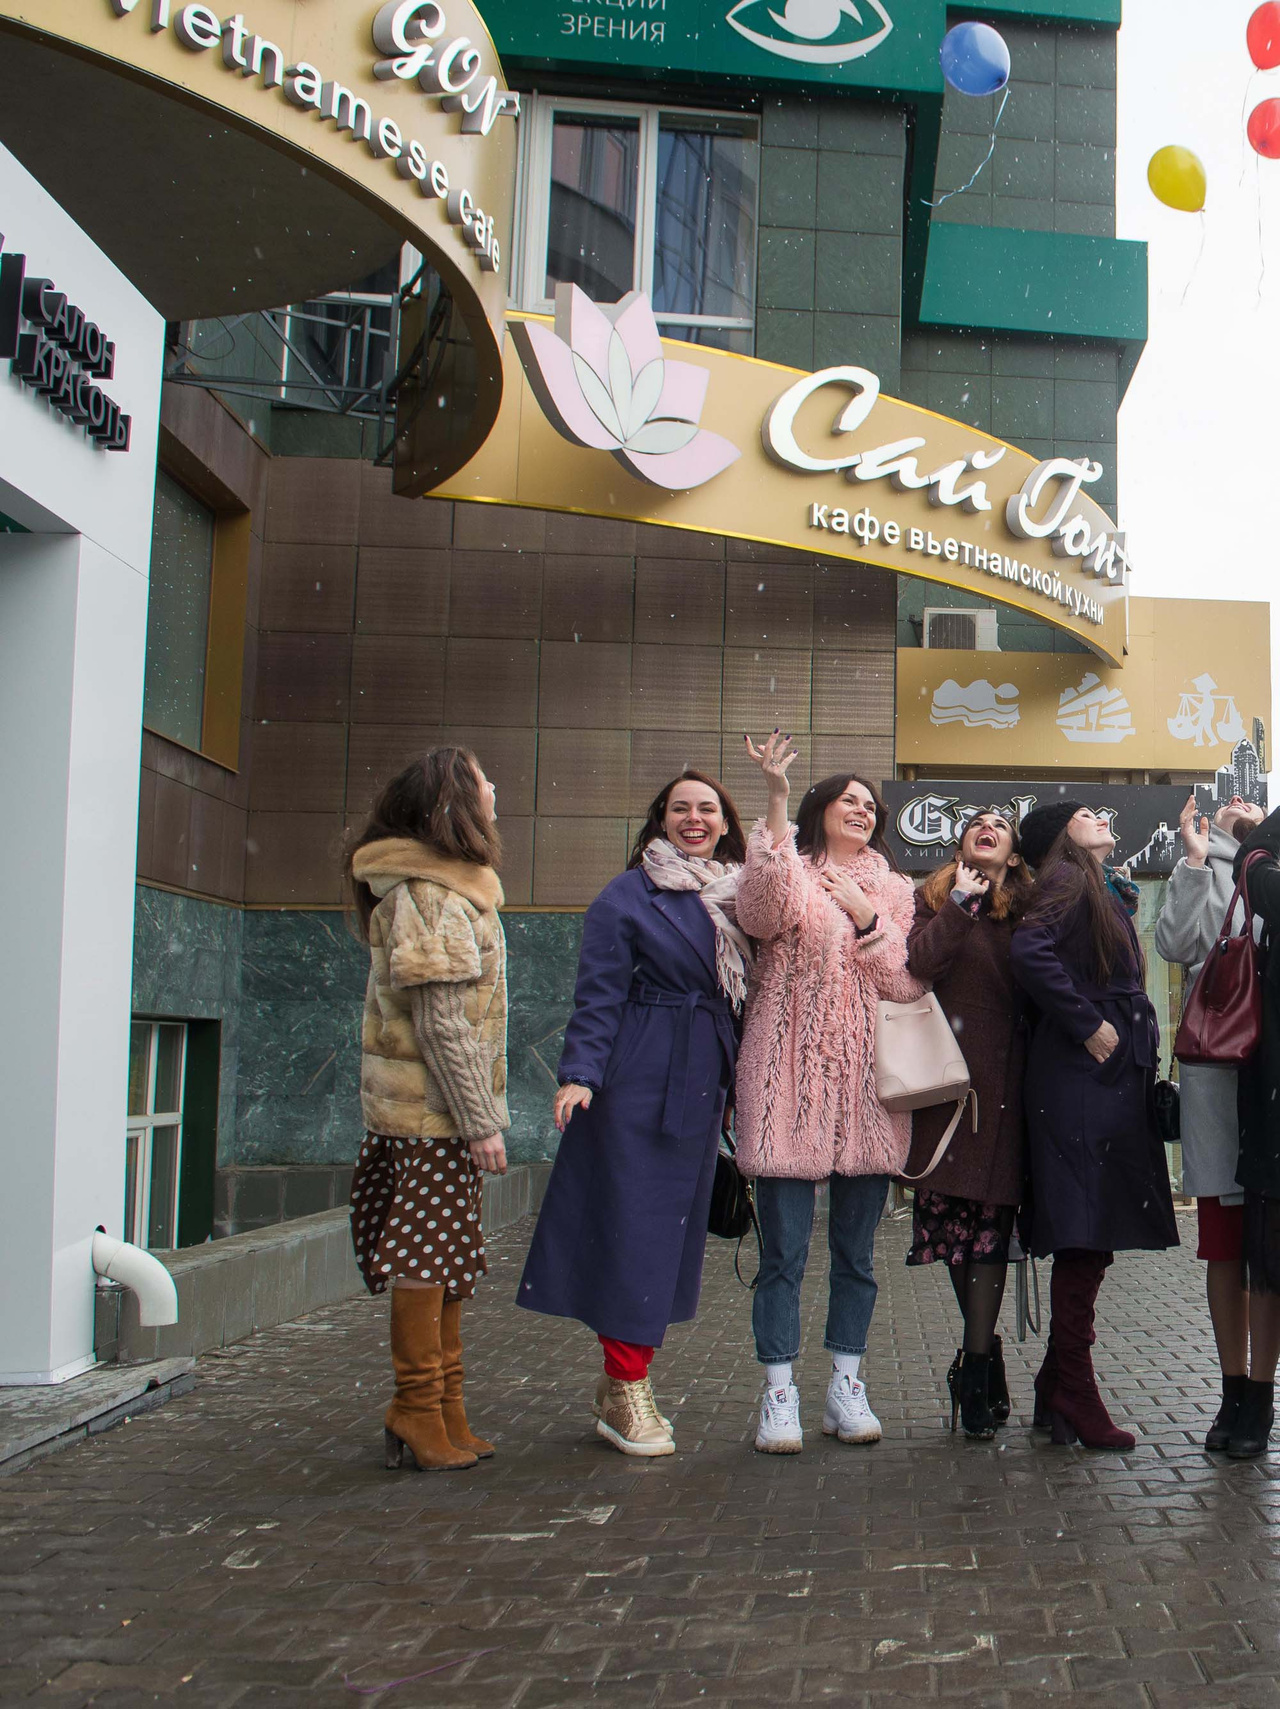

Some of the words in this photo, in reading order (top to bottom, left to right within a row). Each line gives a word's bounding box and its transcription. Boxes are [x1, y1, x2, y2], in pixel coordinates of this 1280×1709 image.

[560, 13, 666, 42] ЗРЕНИЯ
[113, 0, 449, 200] etnamese
[456, 188, 501, 274] cafe
[30, 277, 116, 380] САЛОН
[764, 365, 1007, 512] Сай
[811, 502, 901, 545] кафе
[908, 527, 1062, 601] вьетнамской
[1064, 583, 1105, 626] кухни
